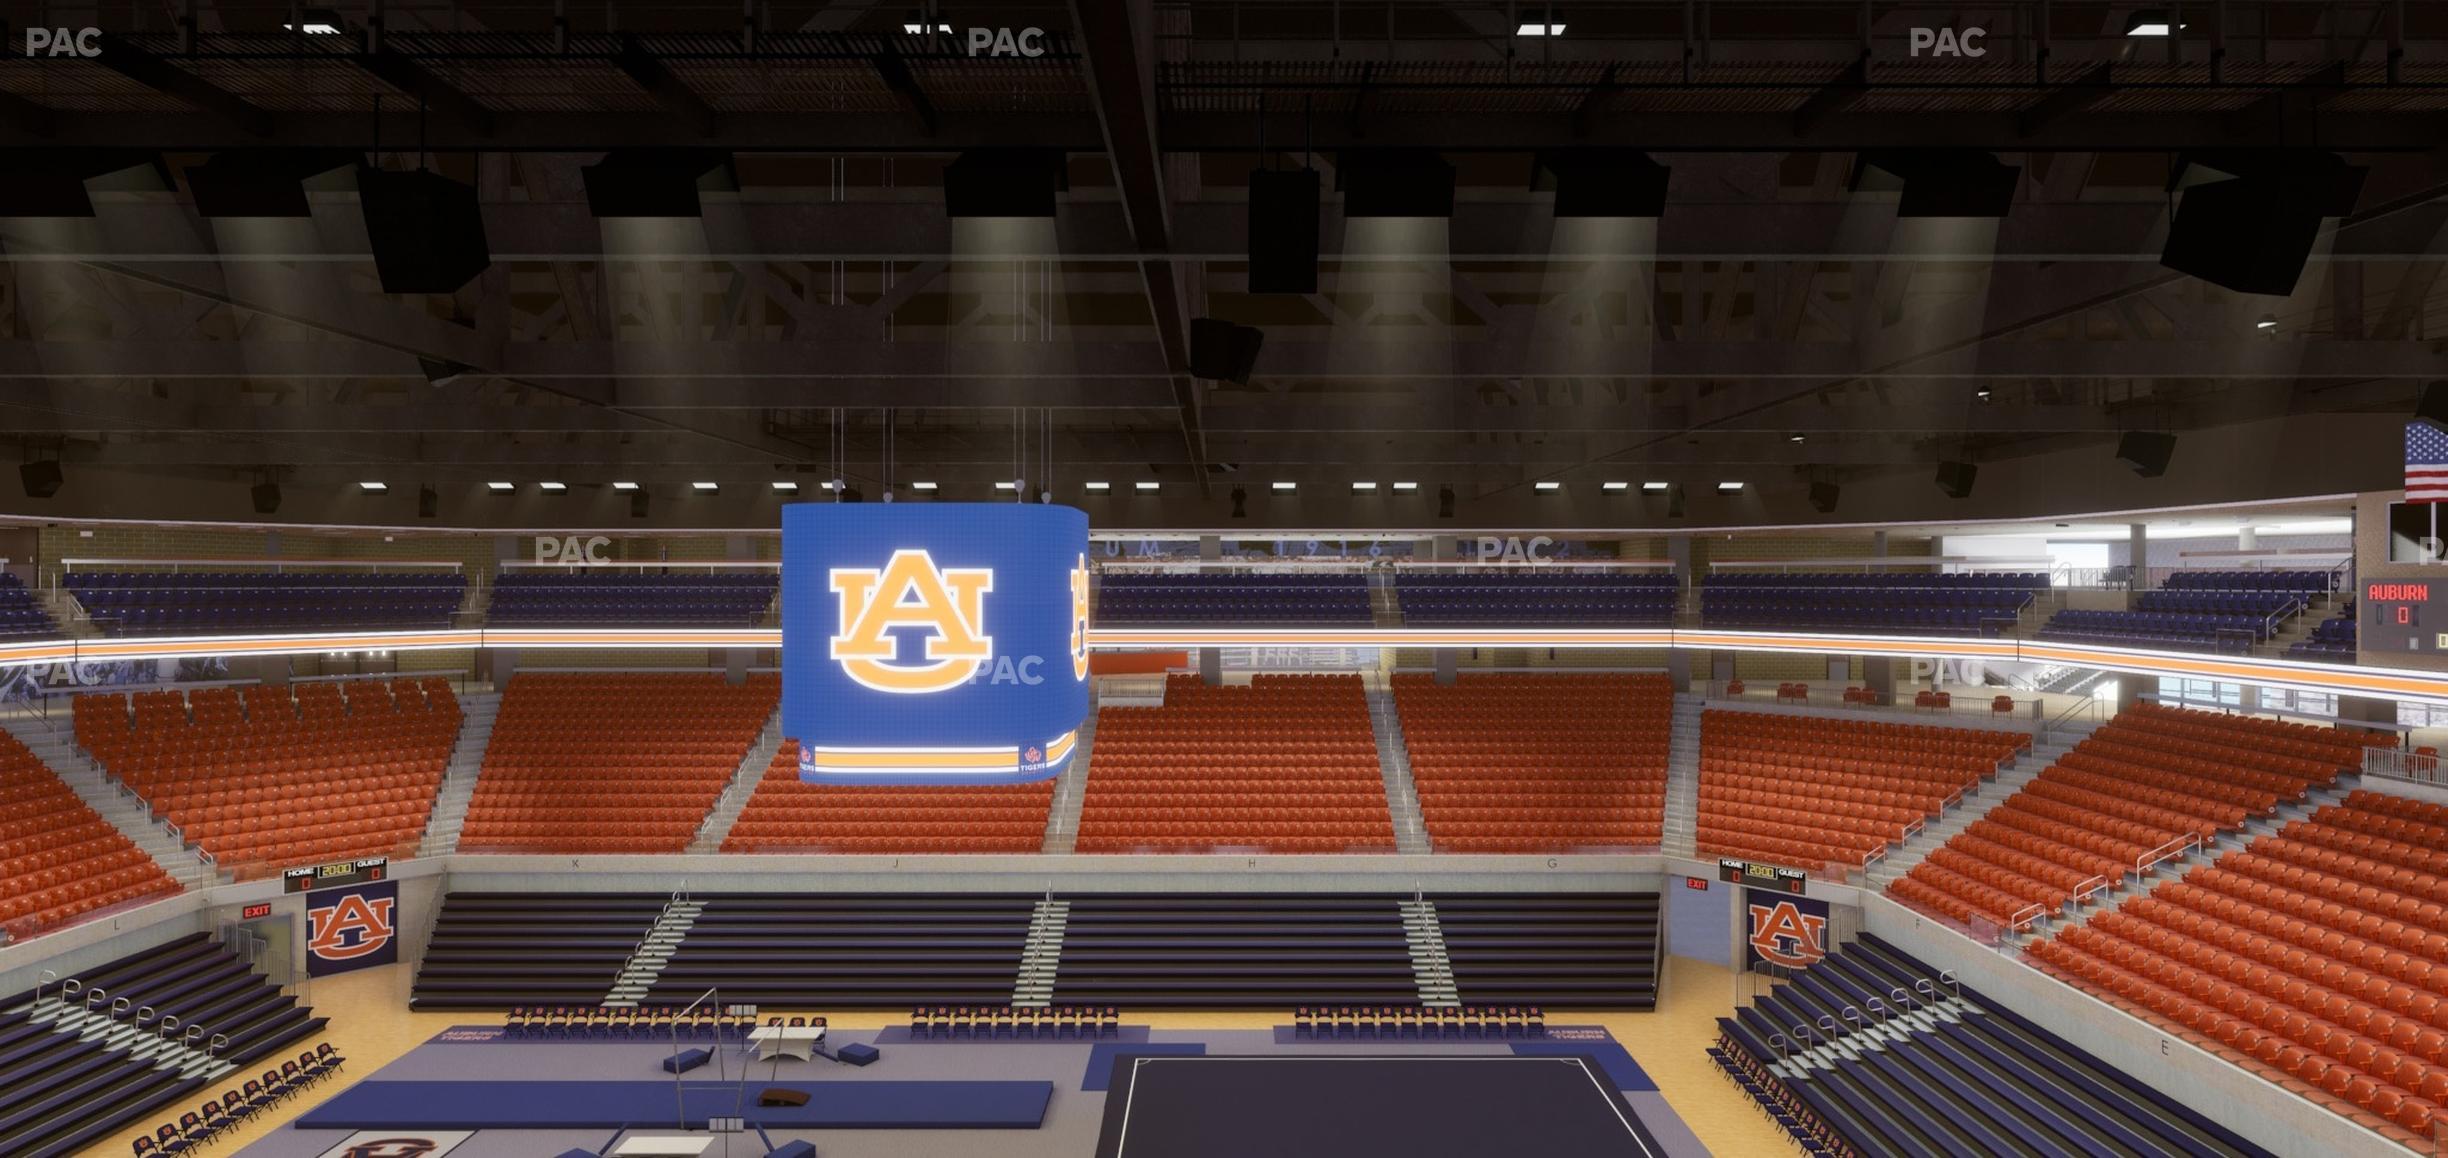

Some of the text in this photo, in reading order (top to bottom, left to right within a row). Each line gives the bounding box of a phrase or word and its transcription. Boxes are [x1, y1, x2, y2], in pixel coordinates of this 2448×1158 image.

[2369, 584, 2428, 601] AUBURN
[2398, 607, 2409, 624] 0
[1020, 763, 1045, 771] TIGERS
[357, 858, 385, 868] GUEST
[572, 859, 580, 869] K
[1248, 858, 1256, 868] H
[1547, 858, 1558, 869] G
[1722, 860, 1744, 869] HOME
[288, 867, 315, 877] HOME
[322, 864, 352, 877] 20:00
[372, 868, 380, 879] 0
[1749, 864, 1774, 877] 20:00
[1779, 868, 1804, 879] GUEST
[1732, 871, 1740, 882] 0
[302, 878, 310, 889] 0
[1687, 878, 1707, 889] EXIT
[1792, 880, 1799, 892] 0
[244, 904, 270, 917] EXIT
[114, 919, 120, 930] L
[2161, 1039, 2169, 1056] E
